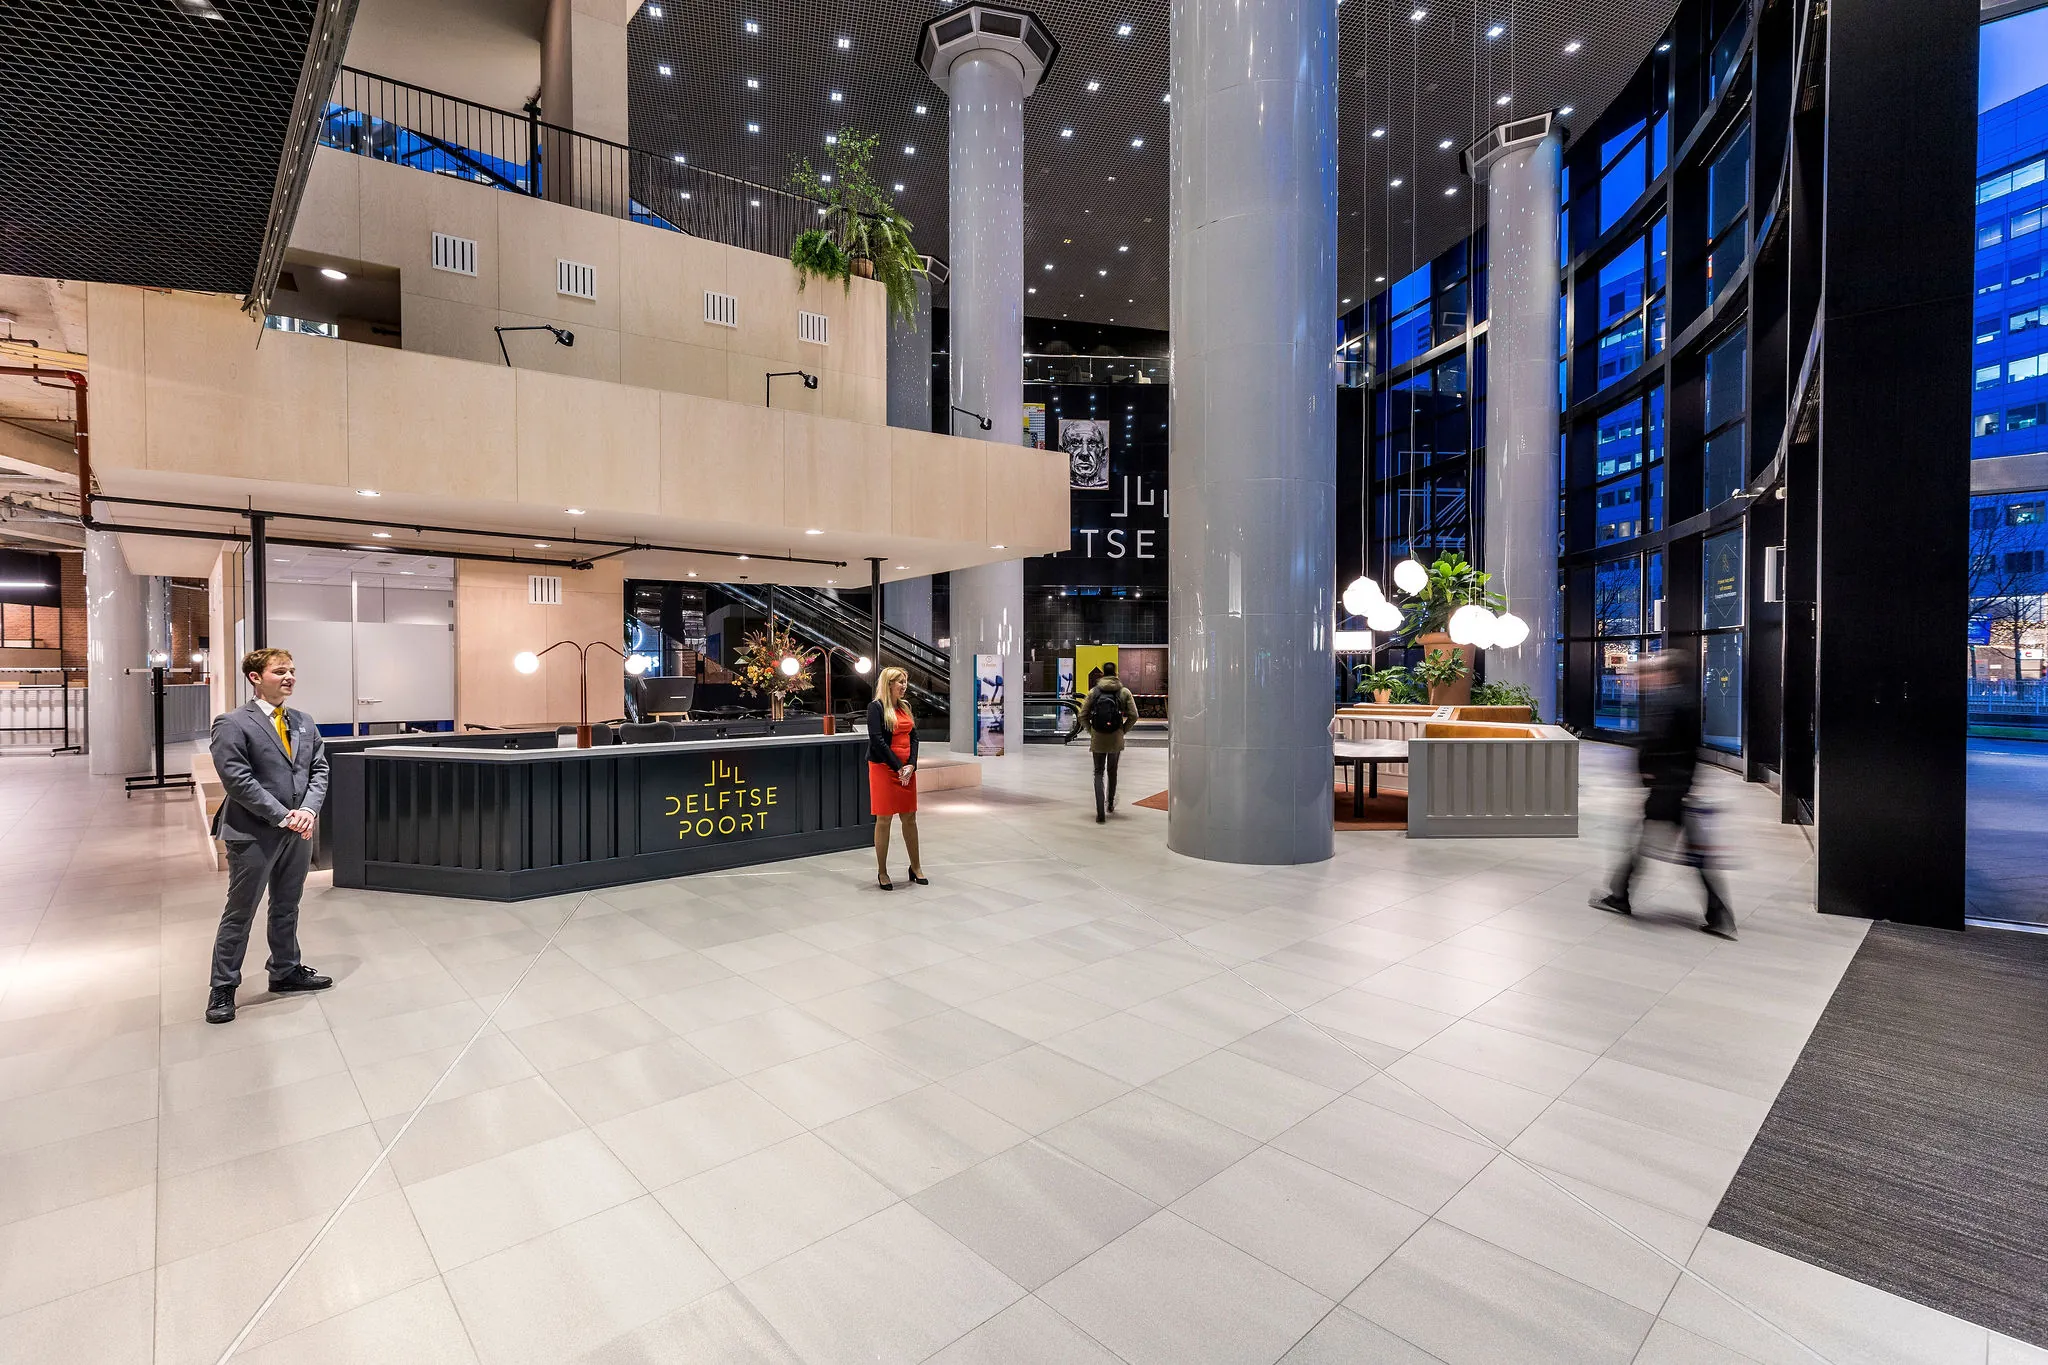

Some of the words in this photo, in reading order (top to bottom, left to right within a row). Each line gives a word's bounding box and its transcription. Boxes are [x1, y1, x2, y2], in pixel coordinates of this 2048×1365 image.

[1030, 529, 1156, 559] TSE
[665, 786, 777, 816] DELFTSE
[679, 811, 768, 840] POORT
